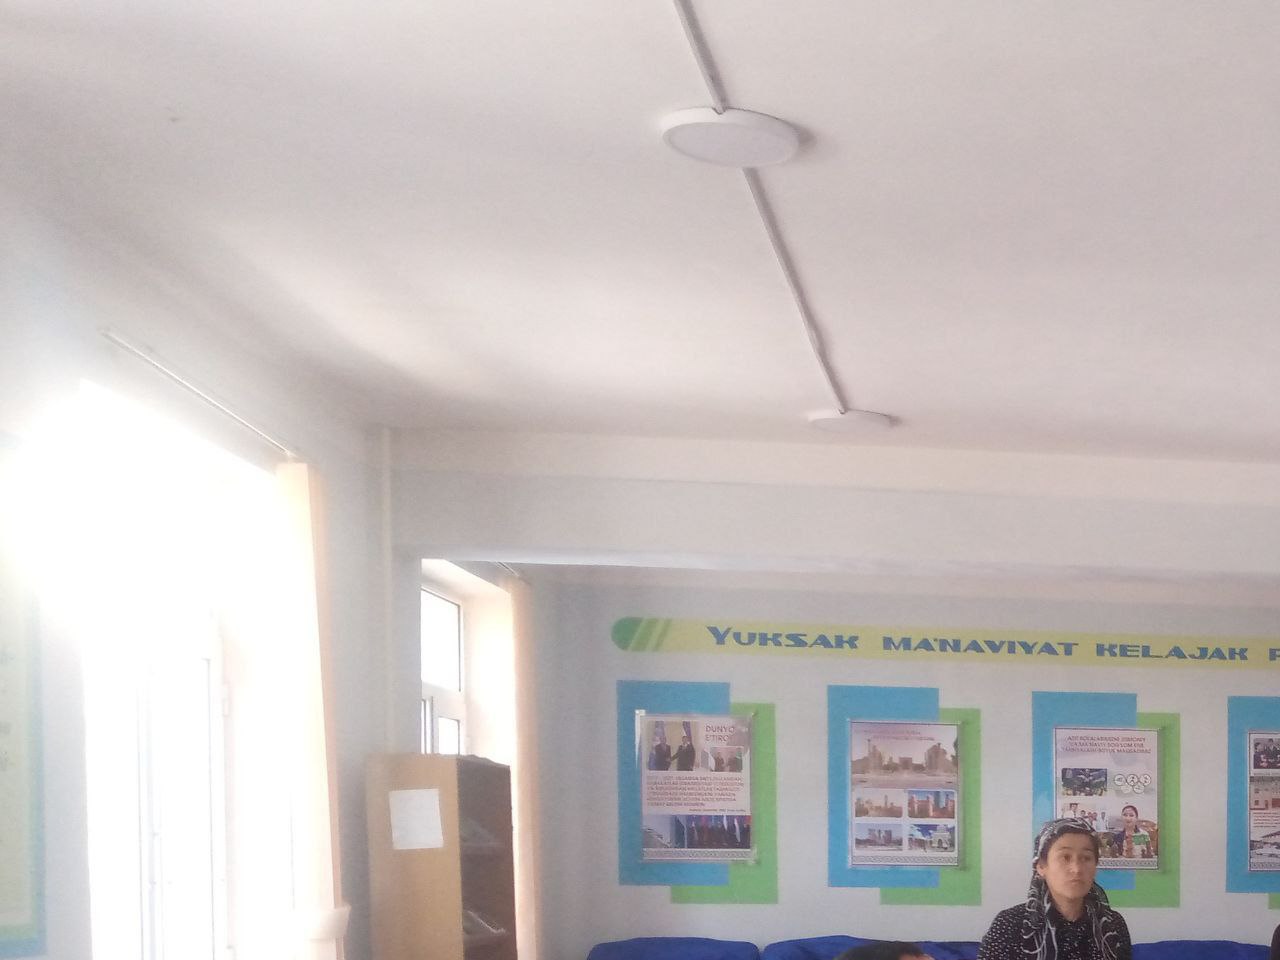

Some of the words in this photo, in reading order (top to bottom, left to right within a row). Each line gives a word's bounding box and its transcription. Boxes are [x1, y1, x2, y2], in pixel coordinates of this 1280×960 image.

[706, 626, 859, 650] YUKSAK
[1096, 643, 1249, 661] KELAJAK
[705, 725, 735, 733] DUNYO
